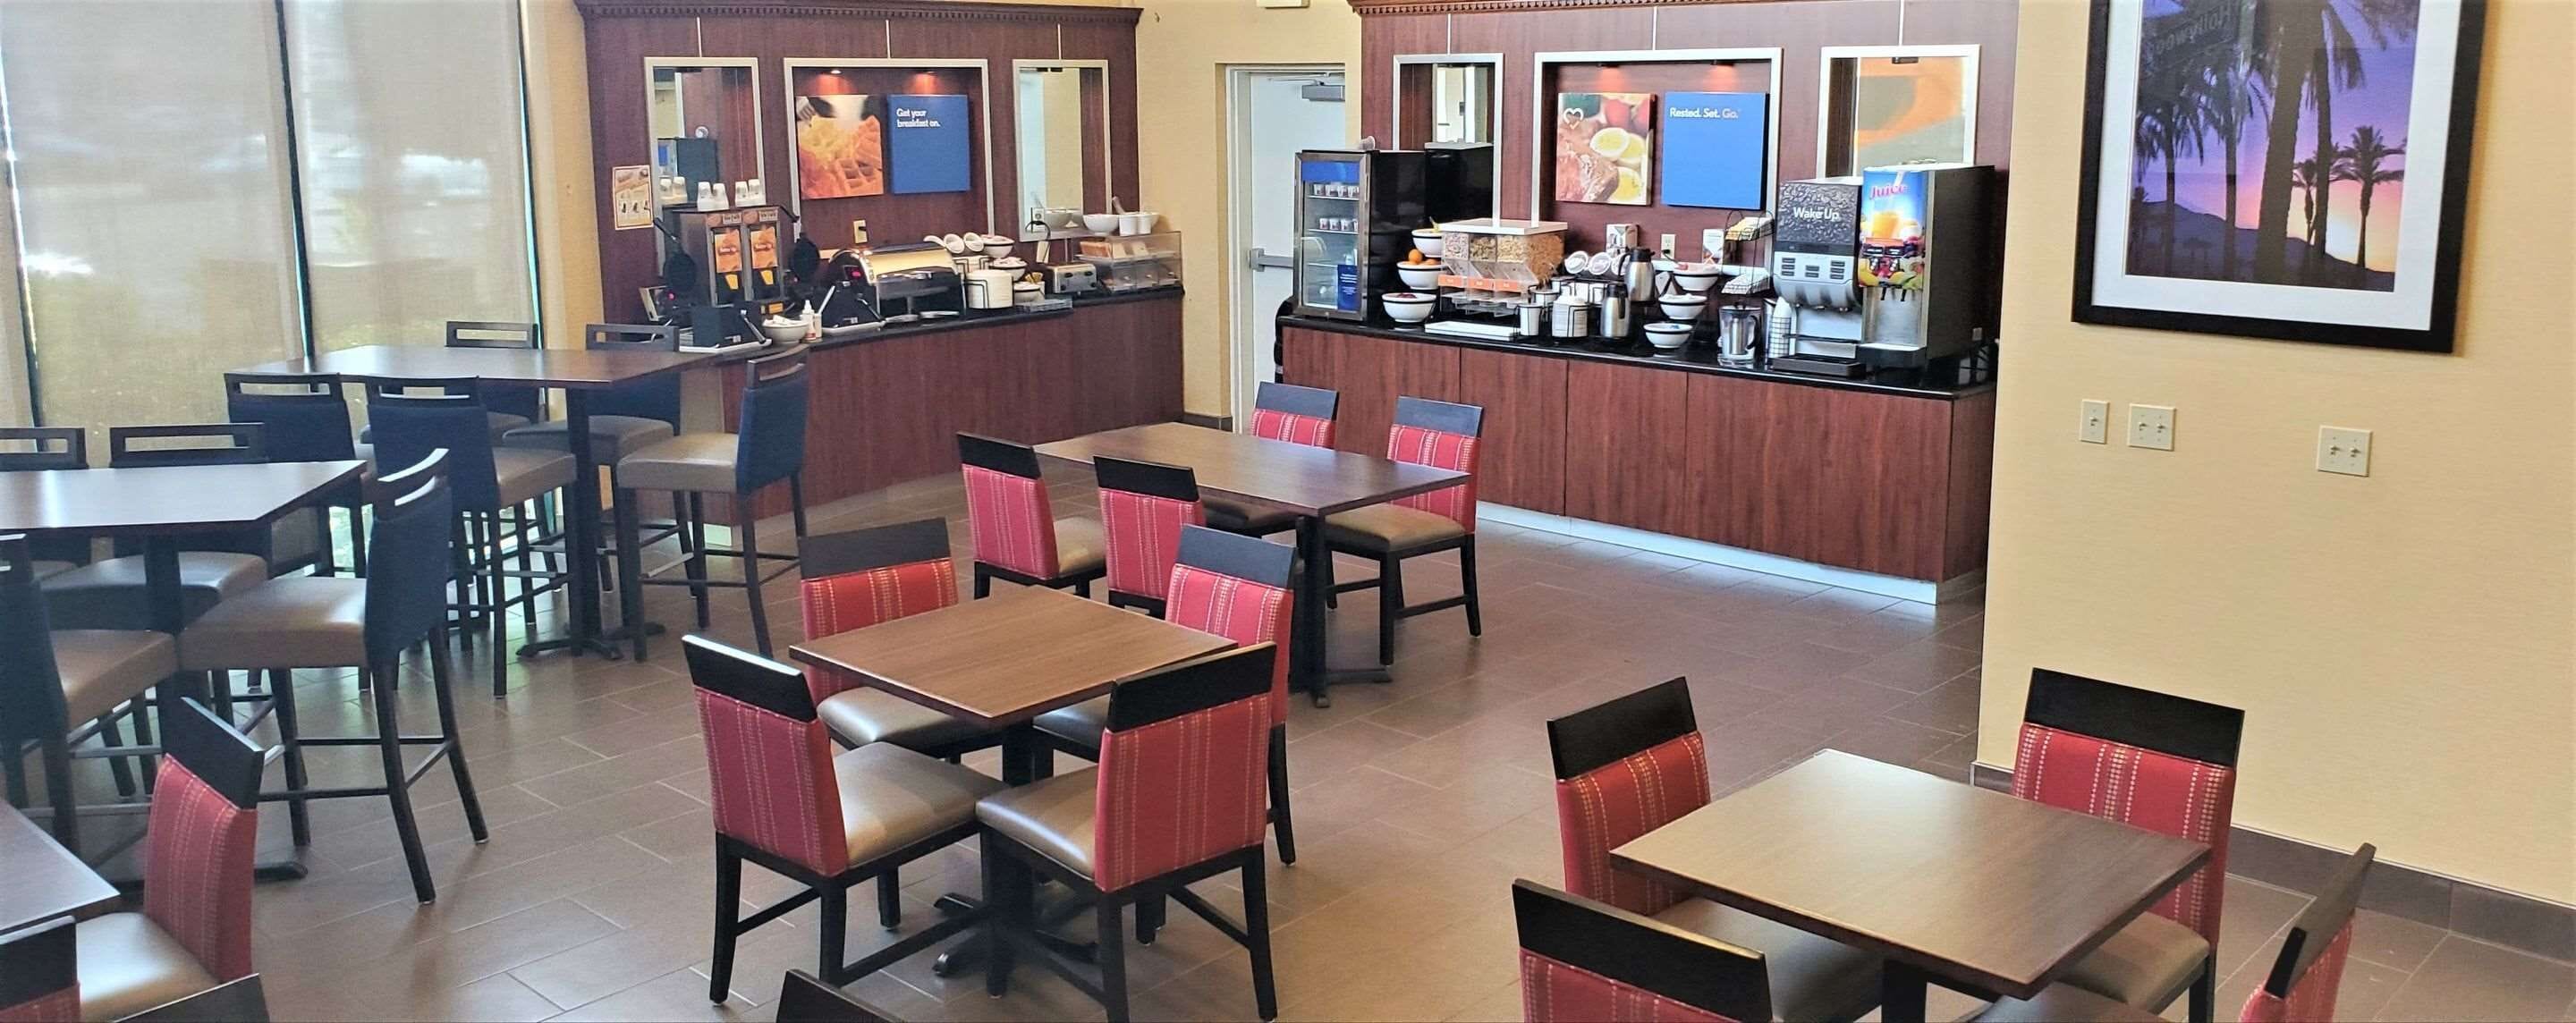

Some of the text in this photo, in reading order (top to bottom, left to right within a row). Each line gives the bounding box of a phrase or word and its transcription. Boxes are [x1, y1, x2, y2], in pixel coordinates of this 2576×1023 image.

[896, 108, 927, 118] Get your
[1670, 107, 1739, 118] Rested. Set. Go.
[897, 119, 928, 127] breakfast
[1870, 183, 1905, 199] Juice
[1793, 207, 1823, 219] Wake
